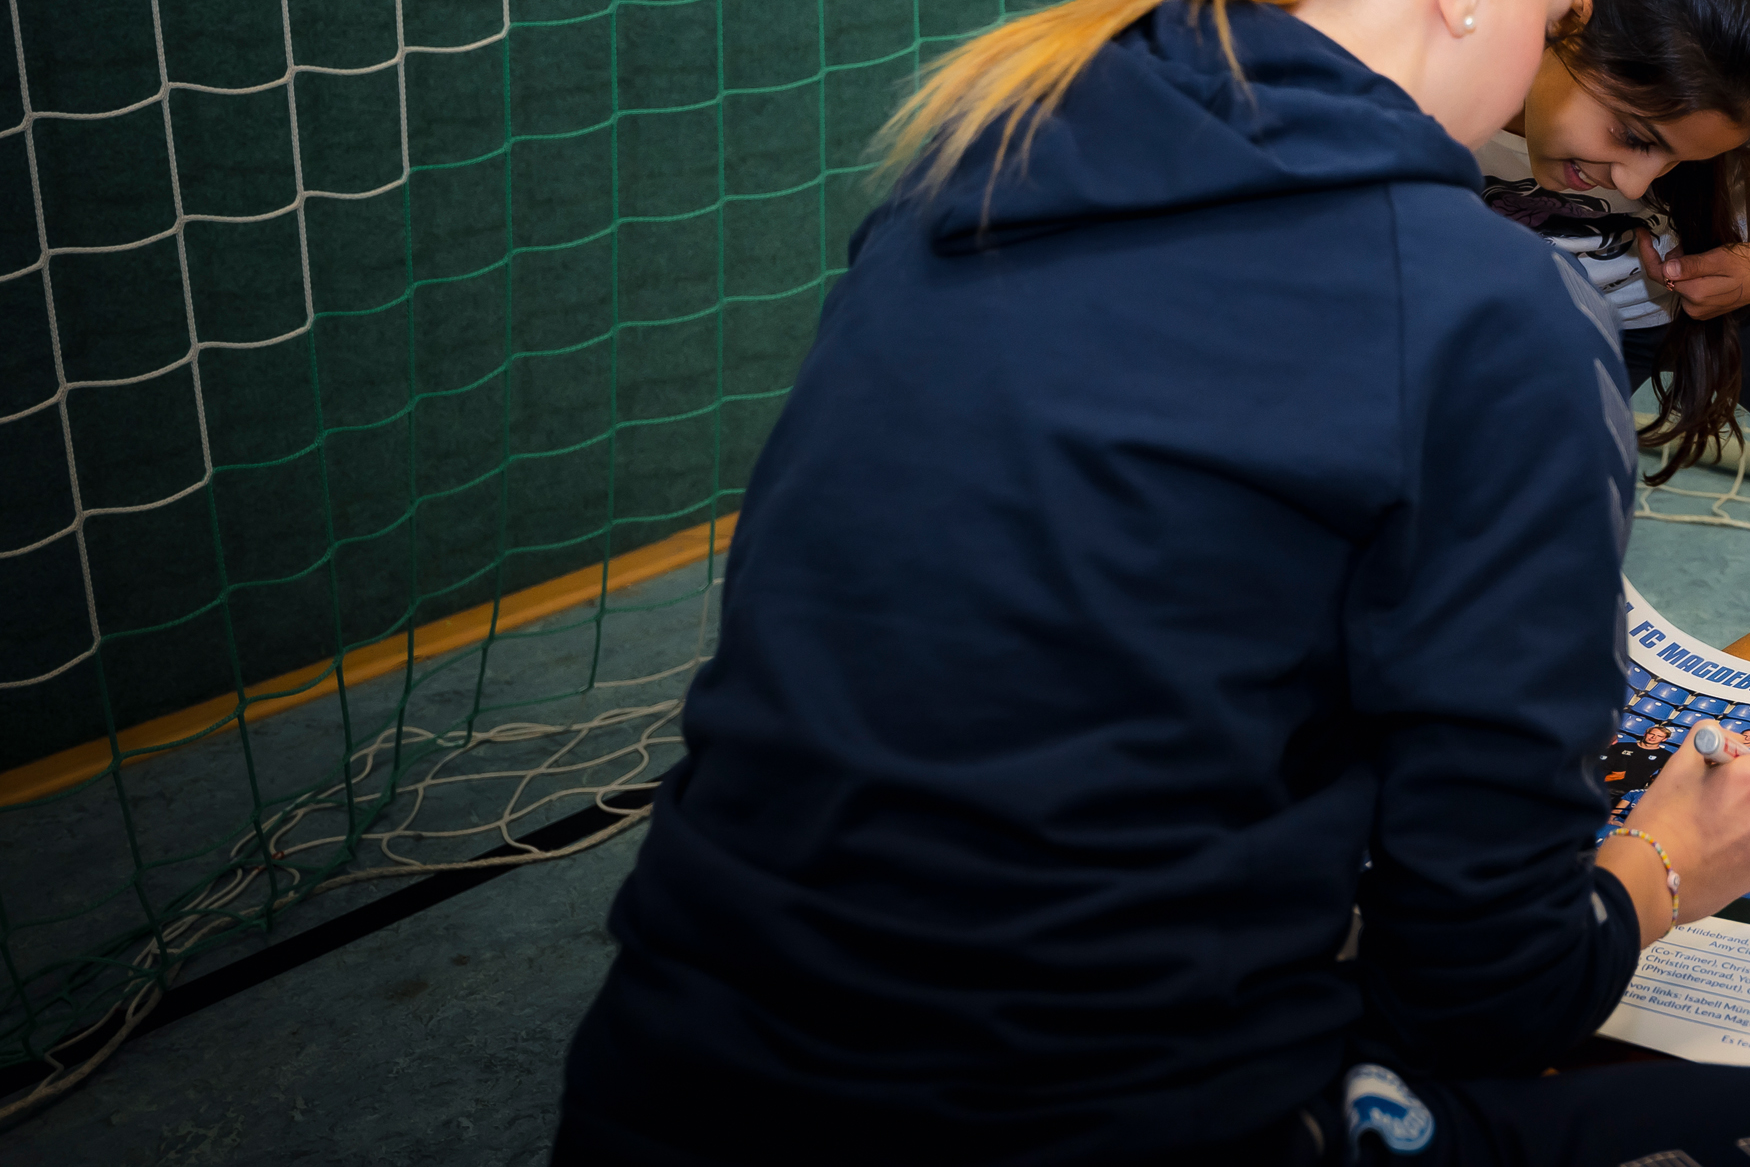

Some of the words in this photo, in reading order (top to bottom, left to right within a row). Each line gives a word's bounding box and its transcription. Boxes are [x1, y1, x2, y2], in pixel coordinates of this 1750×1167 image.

[1629, 620, 1666, 649] FC
[1686, 926, 1750, 947] Hildebrand,
[1709, 941, 1735, 953] Amy
[1645, 954, 1689, 971] Christin
[1692, 965, 1735, 982] Conrad,
[1651, 946, 1718, 968] (Co-Trainer),
[1641, 963, 1743, 993] (Physiotherapeut),
[1630, 983, 1650, 993] von
[1652, 987, 1682, 1000] links:
[1684, 994, 1722, 1009] Isabell
[1648, 996, 1692, 1013] Rudloff,
[1694, 1007, 1721, 1019] Lena
[1721, 1035, 1734, 1045] Es
